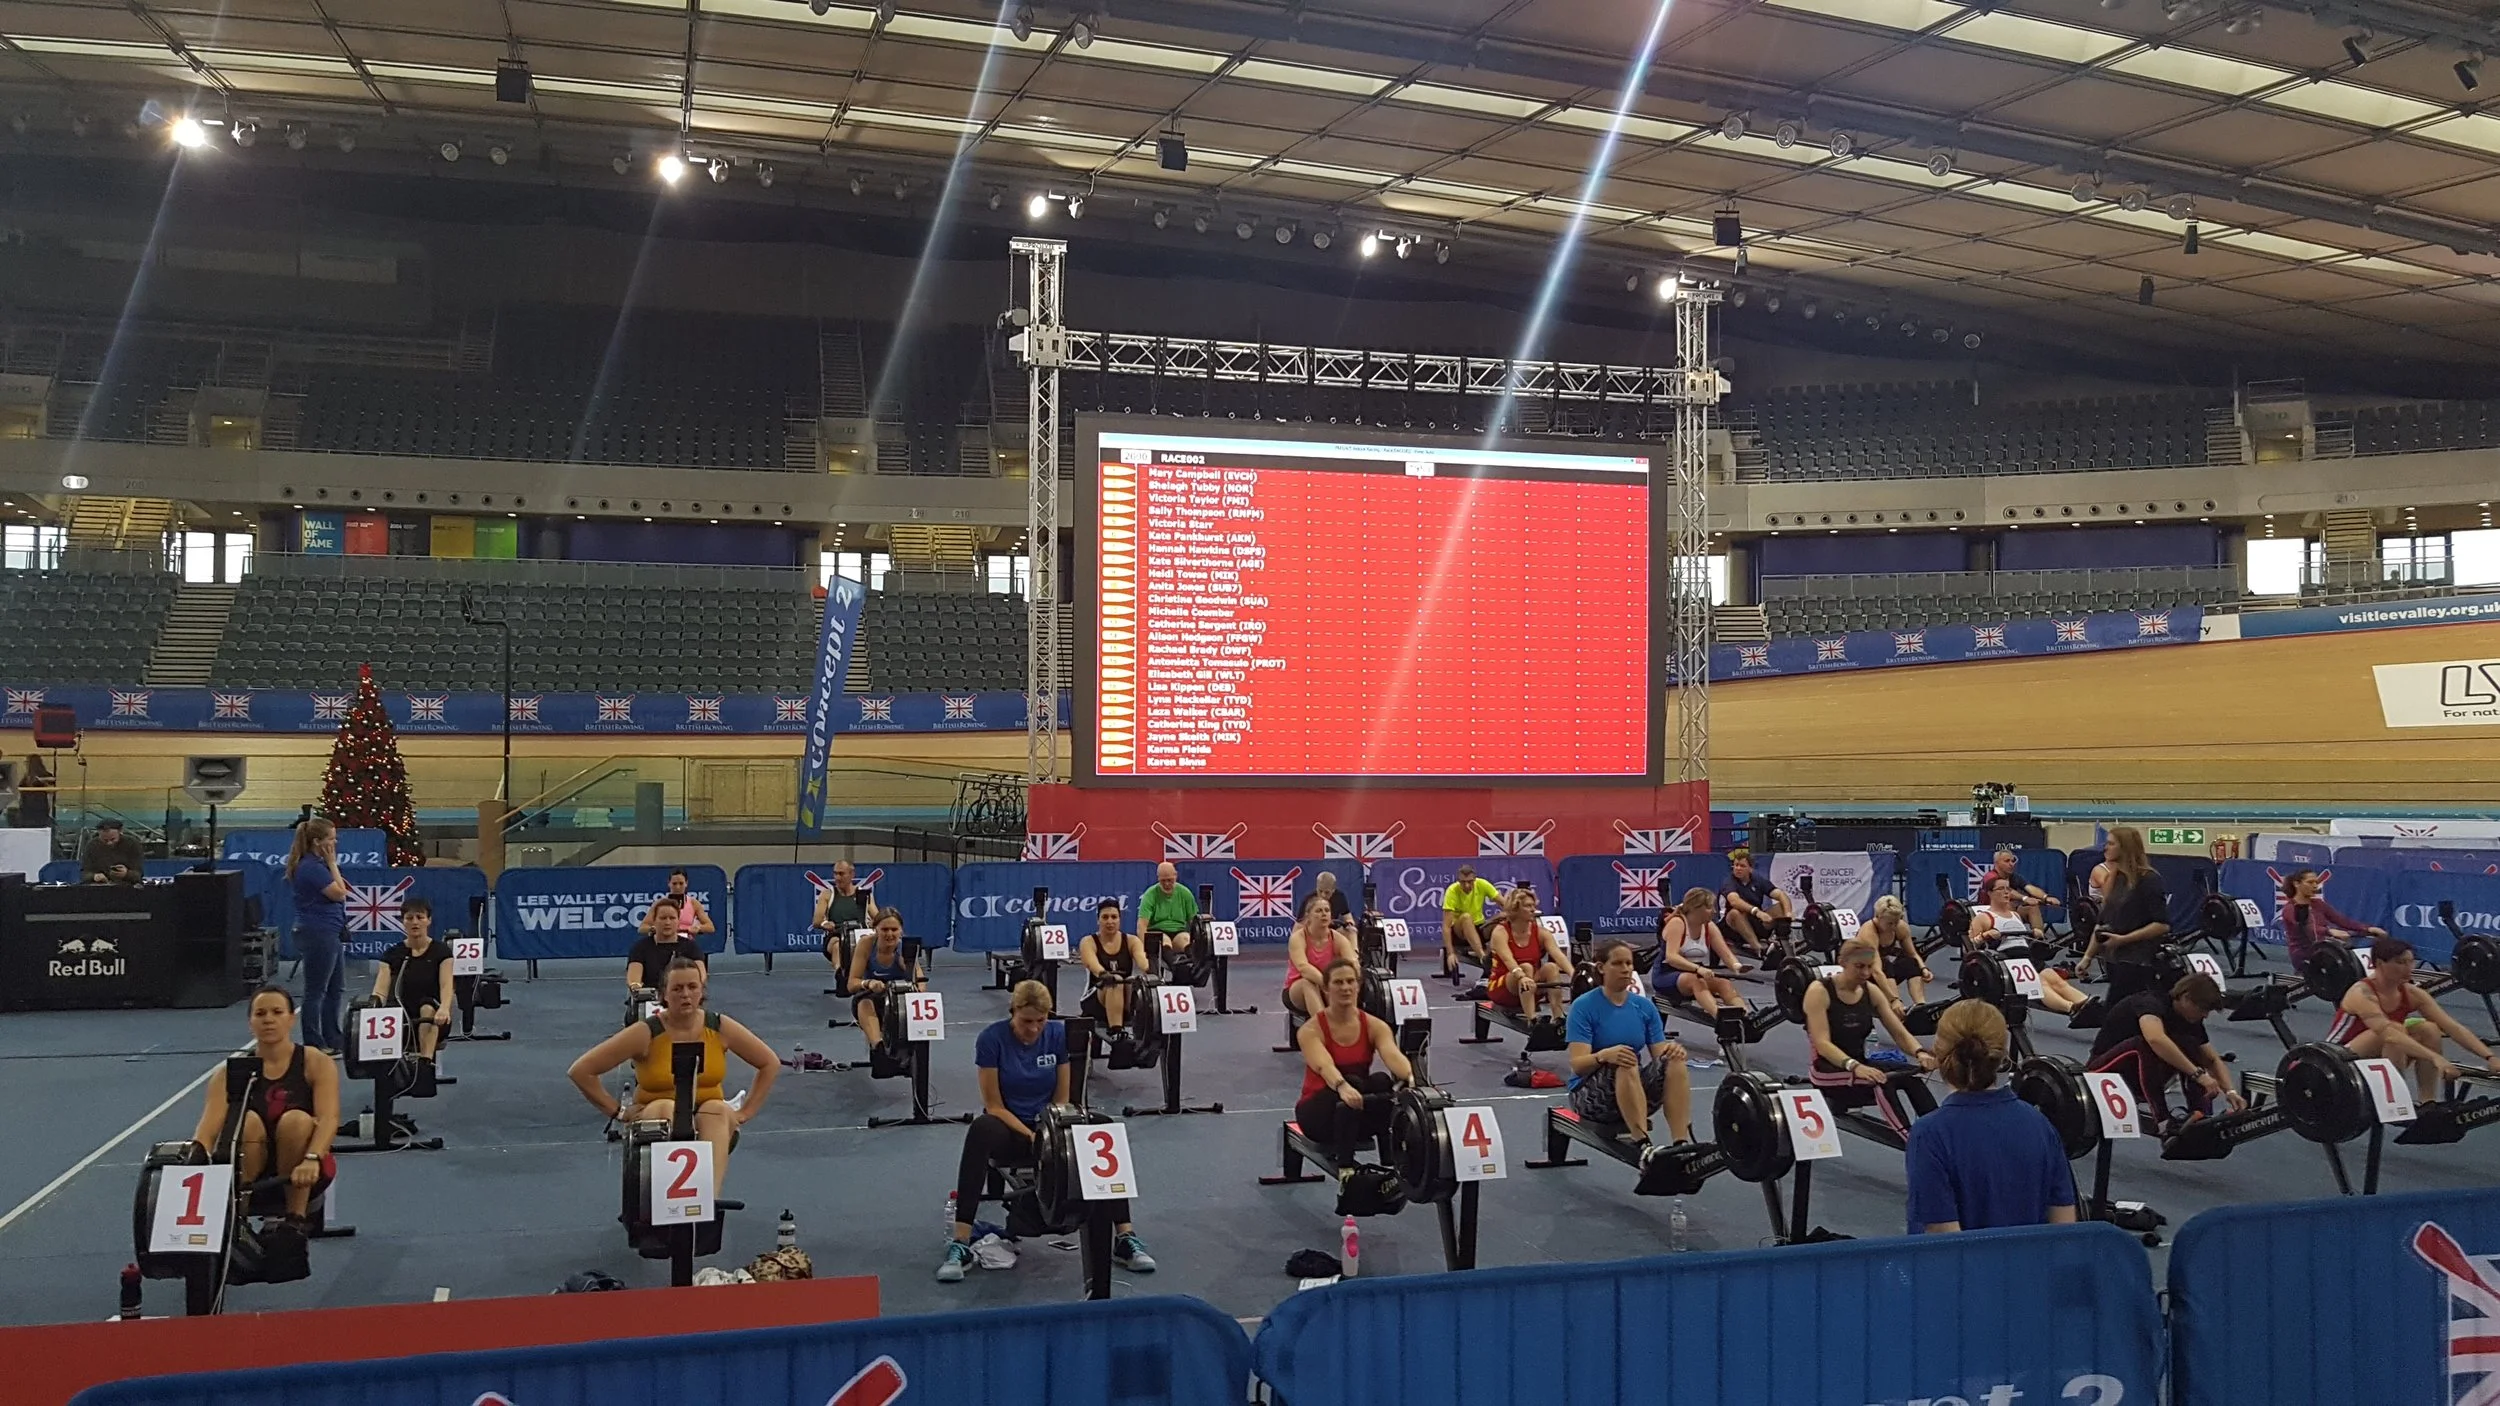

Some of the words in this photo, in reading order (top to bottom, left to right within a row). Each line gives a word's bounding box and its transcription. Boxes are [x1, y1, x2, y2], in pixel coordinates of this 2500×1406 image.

[1161, 454, 1205, 464] RACE002
[1149, 468, 1173, 478] Mary
[1176, 469, 1220, 480] Campbell
[1149, 481, 1188, 491] Shelagh
[1192, 483, 1220, 493] Tubby
[1149, 494, 1186, 503] Victoria
[1189, 495, 1219, 505] Taylor
[1149, 507, 1172, 516] Sally
[1176, 508, 1225, 518] Thompson
[304, 520, 336, 530] WALL
[1149, 519, 1186, 528] Victoria
[1189, 520, 1214, 529] Starr
[304, 530, 318, 540] OF
[1149, 532, 1171, 540] Kate
[1174, 532, 1224, 542] Pankhurst
[304, 538, 333, 549] FAME
[1149, 544, 1186, 552] Hannah
[1189, 545, 1230, 554] Hawkins
[1149, 557, 1171, 566] Kate
[1174, 557, 1234, 567] Silverthorne
[1149, 570, 1174, 578] Heidi
[1148, 582, 1174, 590] Anita
[1177, 583, 1205, 591] Jones
[1148, 594, 1192, 604] Christine
[1195, 596, 1237, 605] Goodwin
[1148, 607, 1189, 616] Michelle
[1148, 620, 1196, 628] Catherine
[1198, 621, 1237, 631] Sargent
[1148, 632, 1178, 641] Alison
[1182, 633, 1223, 643] Hodgson
[1190, 646, 1218, 655] Brady
[812, 615, 847, 769] concept
[836, 585, 852, 610] 2
[1148, 683, 1168, 691] Lisa
[1173, 708, 1208, 717] Walker
[1147, 720, 1195, 728] Catherine
[1198, 721, 1220, 730] King
[1147, 733, 1176, 742] Jayne
[1179, 758, 1206, 766] Binns
[367, 852, 380, 864] 2
[1820, 868, 1854, 876] CANCER
[1430, 874, 1455, 884] VISI
[1820, 877, 1862, 887] RESEARCH
[517, 895, 549, 906] LEE
[551, 893, 620, 906] VALLEY
[620, 891, 710, 904] VELORK
[2240, 903, 2258, 916] 36
[1838, 912, 1856, 926] 33
[1386, 922, 1406, 938] 30
[1408, 926, 1443, 935] ORIDA
[1546, 920, 1566, 934] 31
[1044, 929, 1066, 946] 28
[1214, 926, 1234, 942] 29
[457, 942, 480, 960] 25
[49, 959, 87, 976] Red
[89, 958, 126, 976] Bull
[2197, 958, 2219, 976] 21
[2012, 964, 2036, 983] 20
[1396, 984, 1418, 1007] 17
[1162, 992, 1190, 1014] 16
[911, 999, 939, 1021] 15
[365, 1015, 397, 1041] 13
[2367, 1064, 2397, 1104] 7
[2100, 1077, 2129, 1120] 6
[1792, 1095, 1825, 1140] 5
[1462, 1112, 1492, 1158] 4
[1087, 1130, 1119, 1178] 3
[666, 1147, 699, 1200] 2
[176, 1172, 206, 1226] 1
